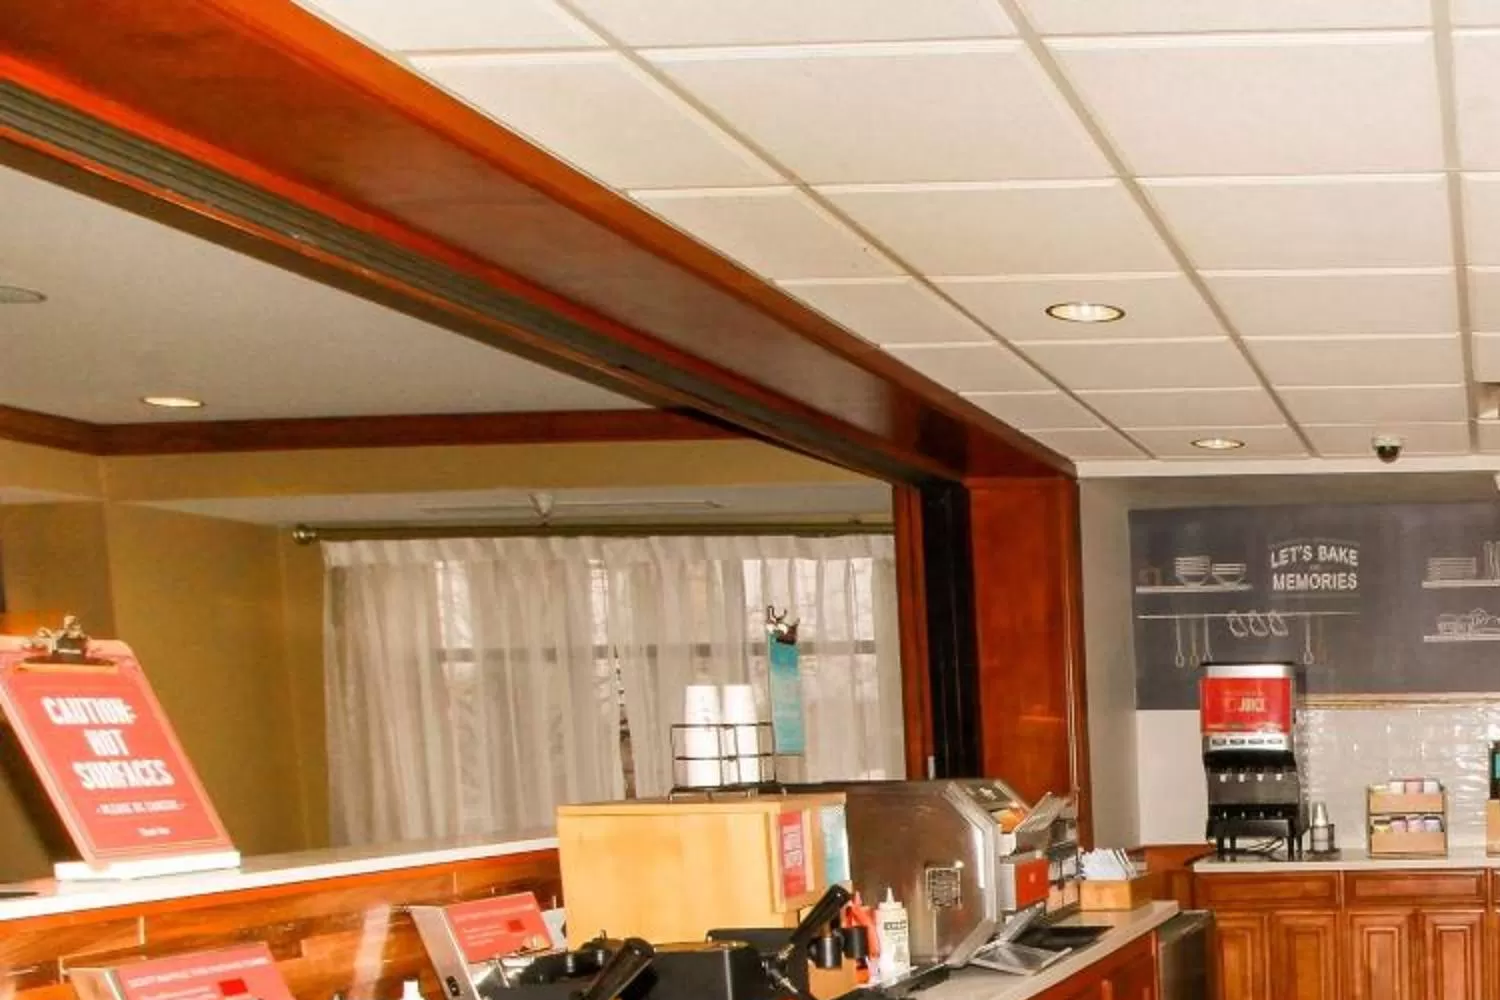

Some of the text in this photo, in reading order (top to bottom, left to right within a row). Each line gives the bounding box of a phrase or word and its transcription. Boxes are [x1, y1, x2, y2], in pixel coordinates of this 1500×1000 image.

[1271, 545, 1358, 569] LET'S BAKE
[1273, 573, 1357, 591] MEMORIES
[83, 728, 129, 757] HOT
[71, 758, 176, 791] SURFACES
